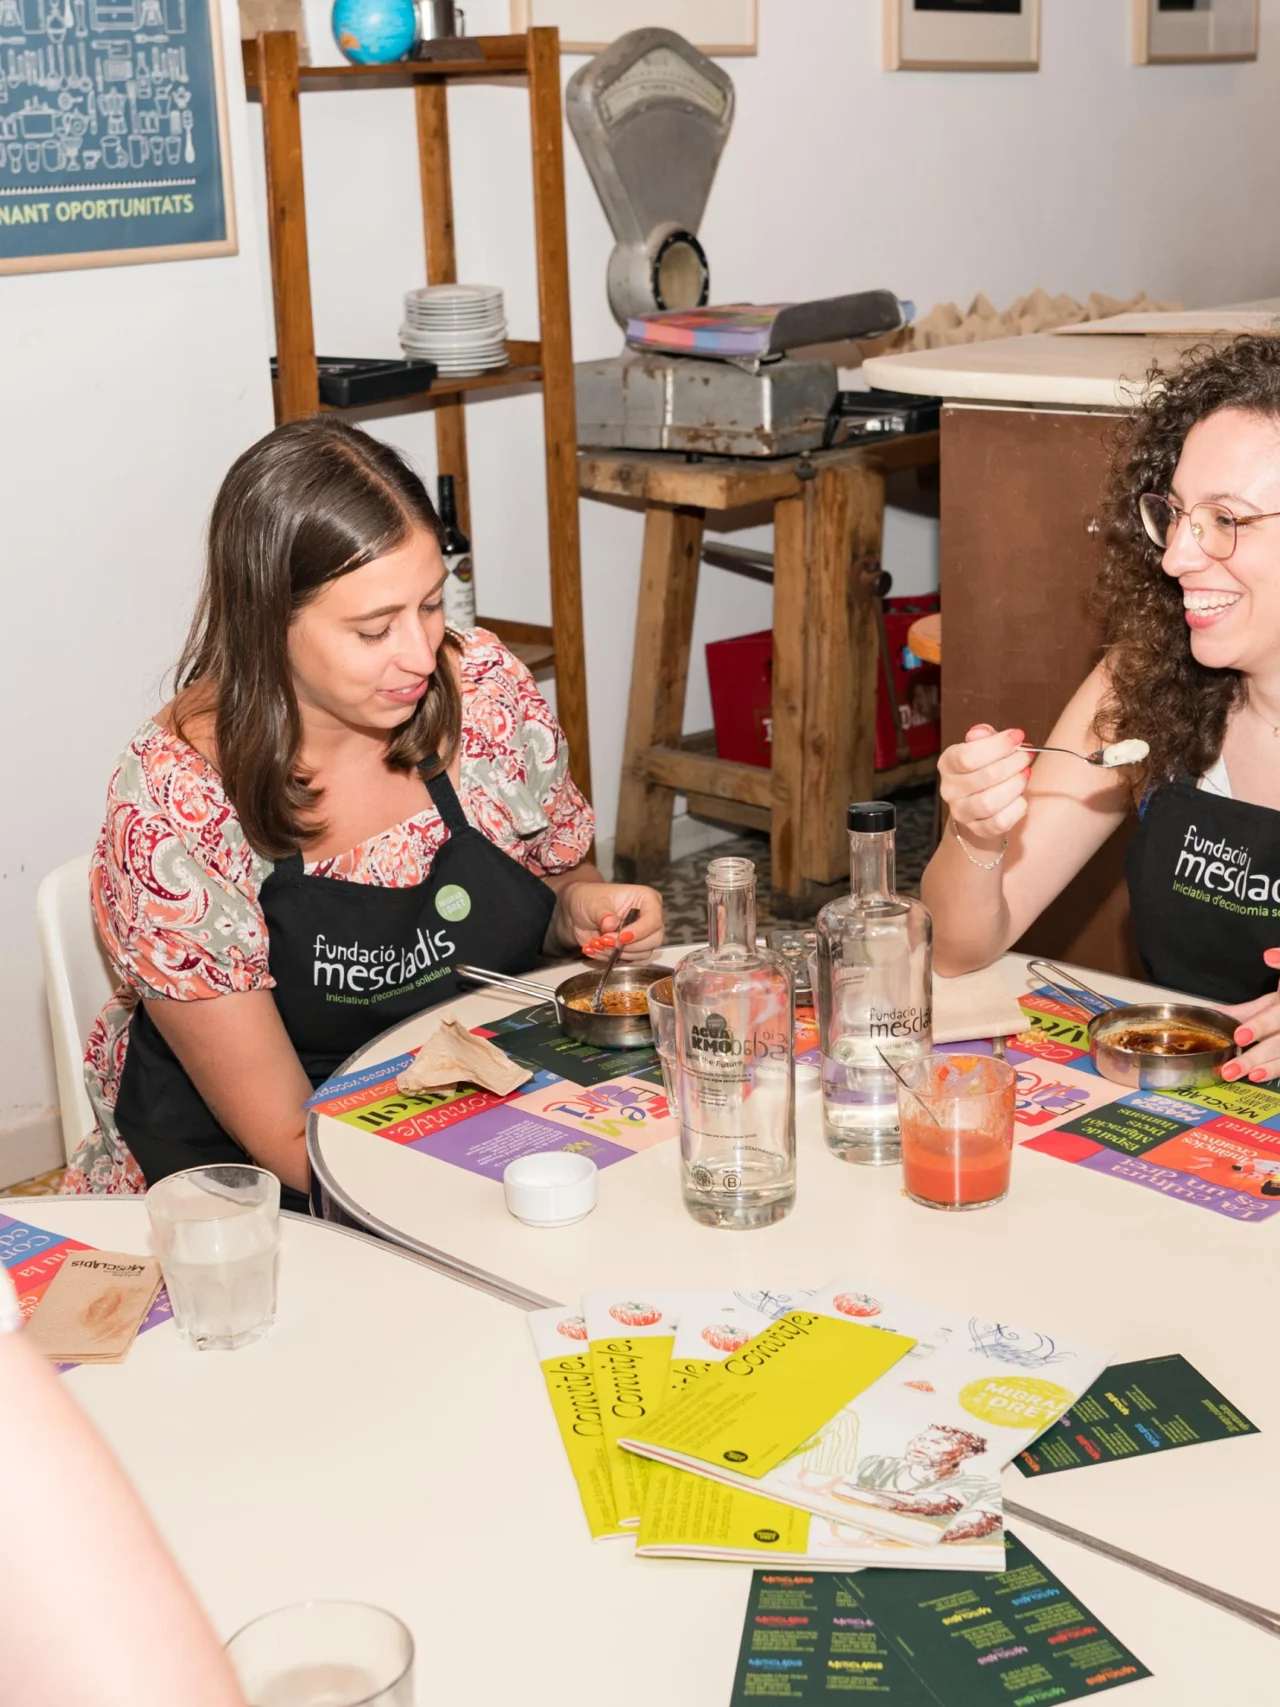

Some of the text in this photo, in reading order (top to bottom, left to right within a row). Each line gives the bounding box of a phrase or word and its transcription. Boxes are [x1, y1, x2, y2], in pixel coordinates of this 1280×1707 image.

[56, 194, 194, 222] OPORTUNITATS
[1184, 825, 1248, 866] fundació
[1173, 879, 1210, 904] Iniciativa
[1212, 894, 1269, 917] d'economia
[313, 934, 395, 964] fundació
[326, 965, 452, 1005] Iniciativa d'economia solidària
[691, 1025, 730, 1039] AGUA
[1117, 1108, 1180, 1130] Humans
[1127, 1120, 1166, 1137] Drets
[1082, 1126, 1141, 1151] Espai de
[1191, 1131, 1258, 1158] Creatives
[1111, 1164, 1257, 1219] La cultura
[1119, 1158, 1270, 1211] és un dret
[18, 1263, 46, 1278] la
[988, 1397, 1057, 1420] DRET
